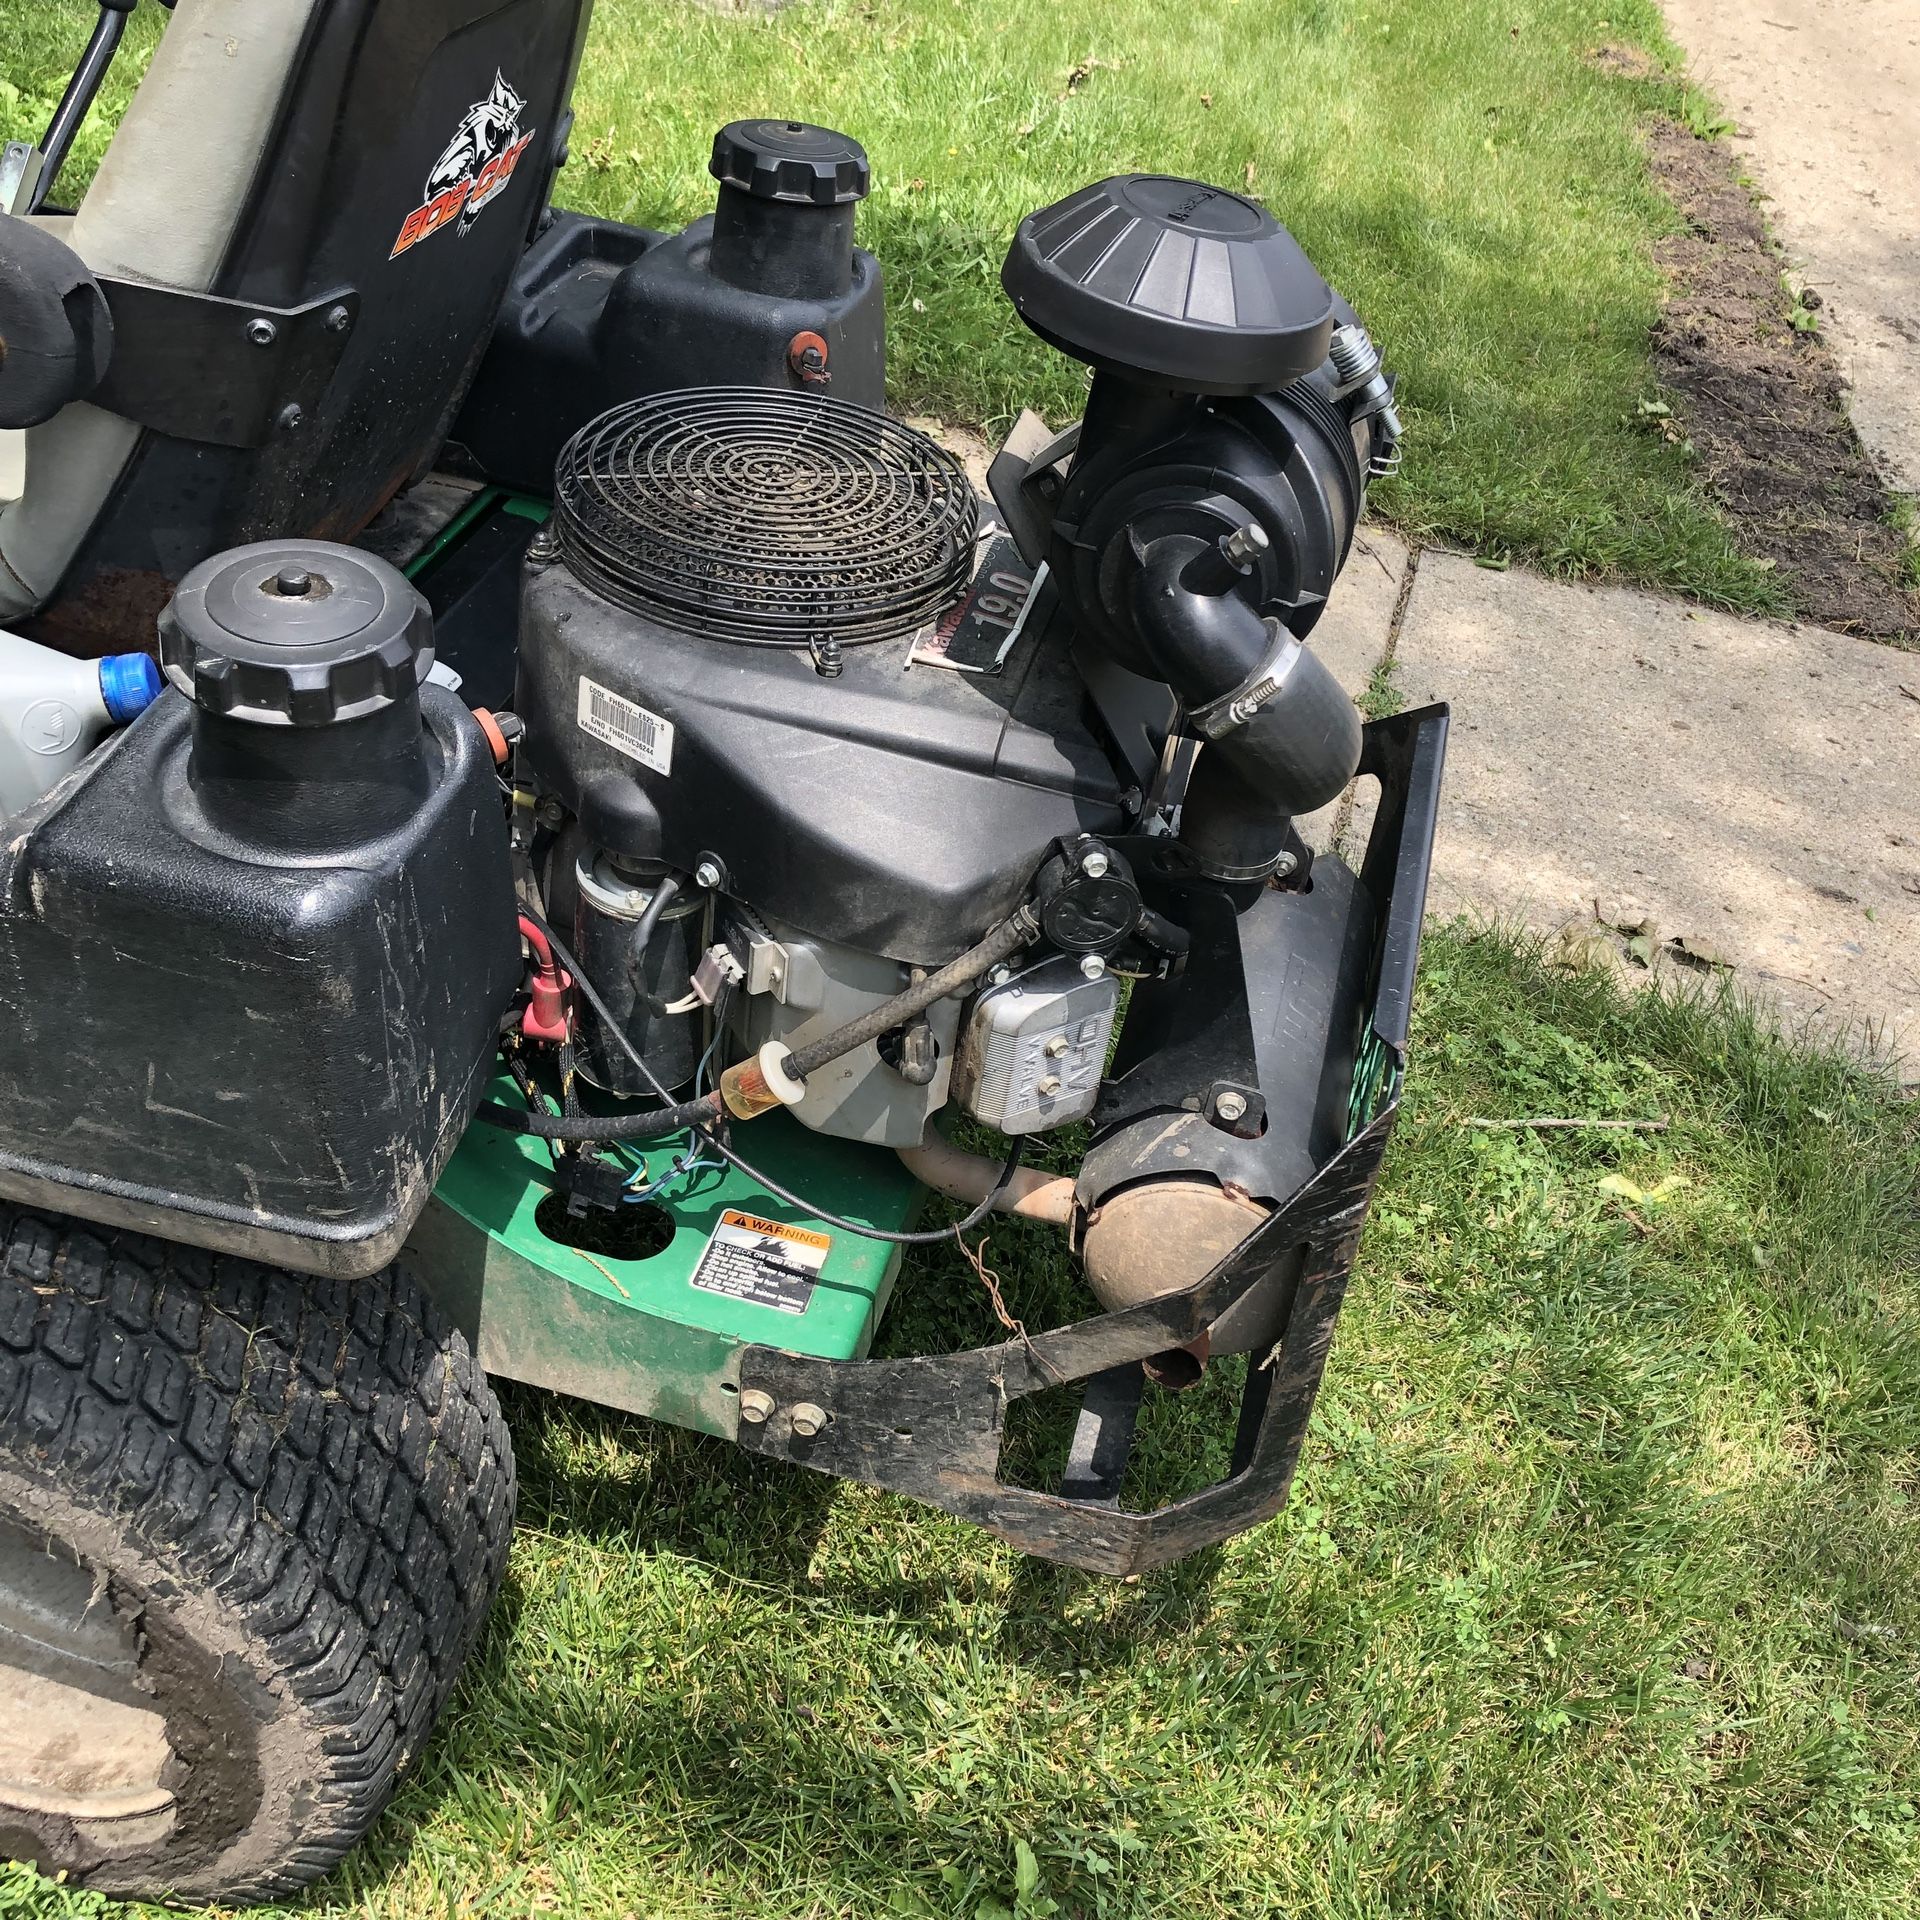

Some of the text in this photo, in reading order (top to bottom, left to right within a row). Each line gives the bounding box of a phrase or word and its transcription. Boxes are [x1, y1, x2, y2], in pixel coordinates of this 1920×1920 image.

[971, 571, 1032, 630] 19.0
[589, 685, 605, 699] CODE
[580, 719, 612, 742] KAWASAKI
[657, 761, 665, 770] USA
[1067, 1018, 1099, 1090] OHV
[752, 1219, 821, 1245] WARNING
[725, 1245, 752, 1255] CHECK
[732, 1253, 765, 1265] outdoors.
[756, 1265, 776, 1274] Allow
[786, 1273, 804, 1281] cool.
[754, 1289, 777, 1298] below
